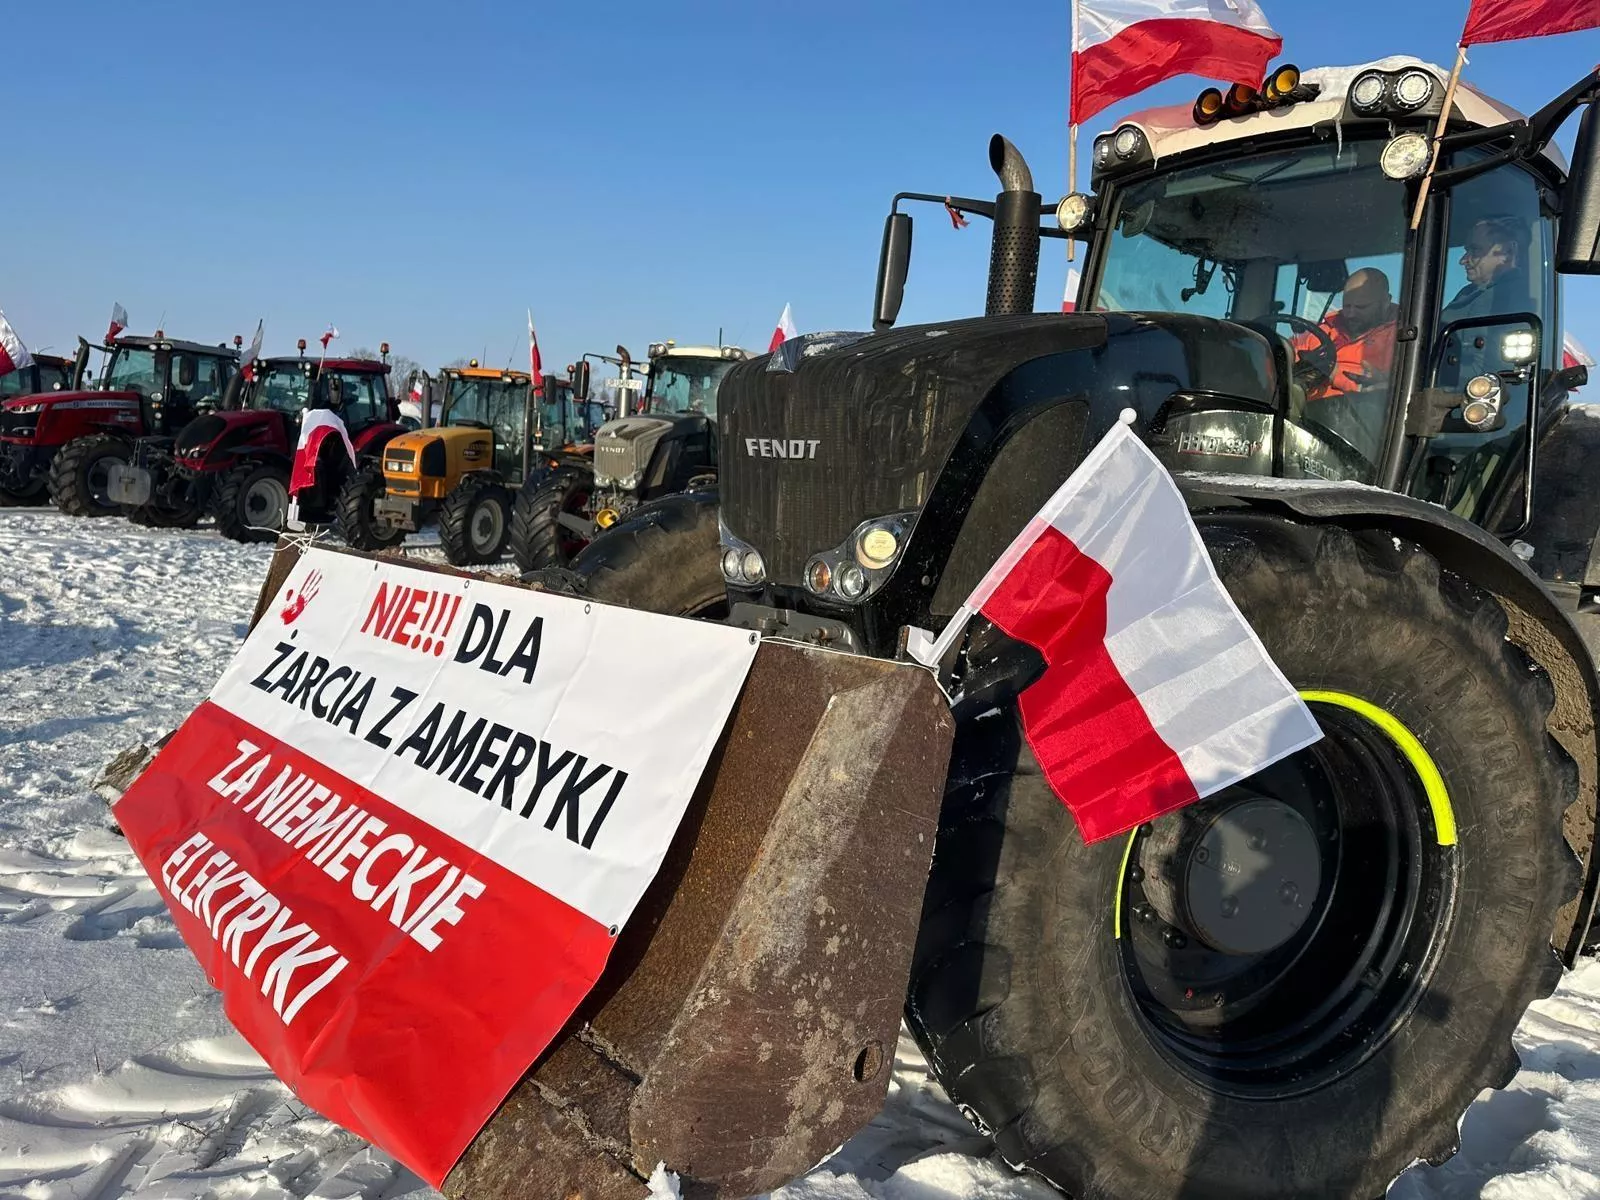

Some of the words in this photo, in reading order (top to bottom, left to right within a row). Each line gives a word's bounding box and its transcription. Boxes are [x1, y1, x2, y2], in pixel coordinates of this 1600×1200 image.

[745, 438, 821, 459] FENDT
[360, 581, 463, 658] NIE!!!
[454, 603, 544, 684] DLA
[250, 629, 378, 735] ŻARCIA
[371, 685, 420, 749] Z
[398, 702, 629, 850] AMERYKI
[161, 832, 349, 1027] ELEKTRYKI
[206, 739, 268, 805] ZA
[247, 764, 487, 953] NIEMIECKIE
